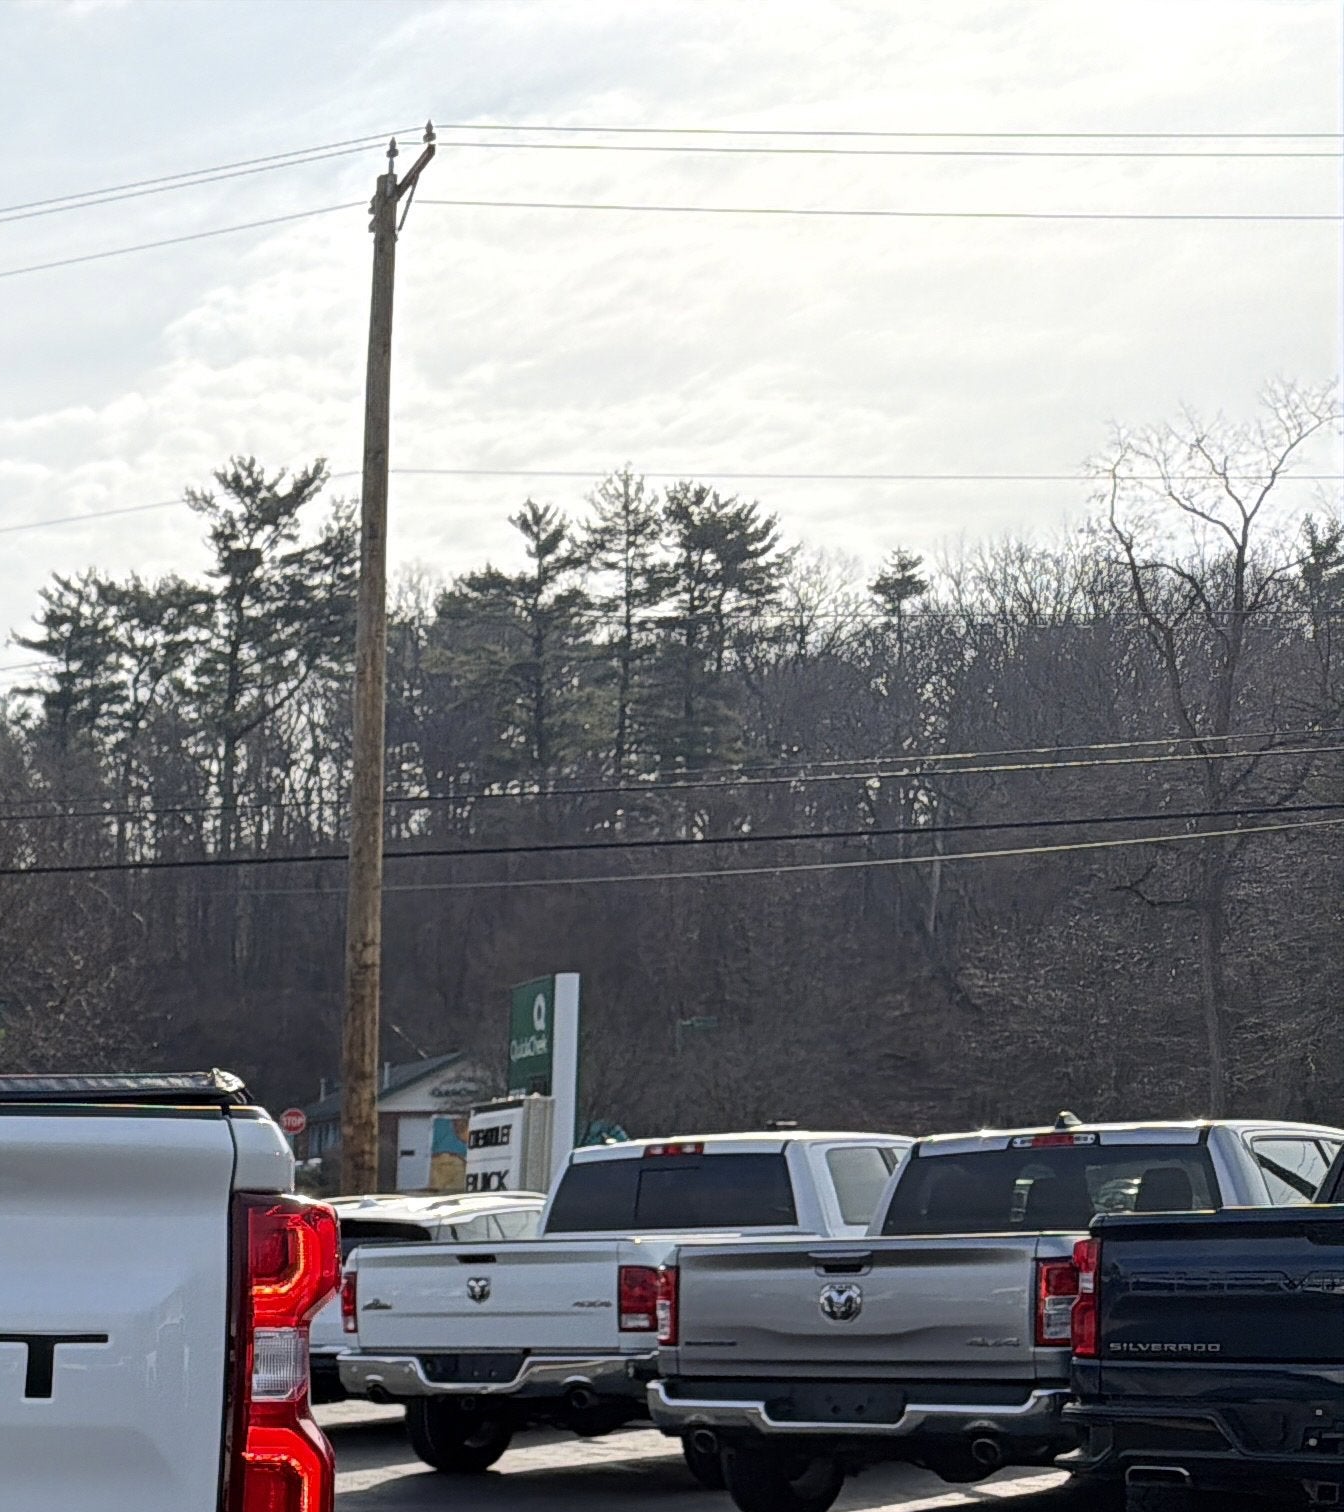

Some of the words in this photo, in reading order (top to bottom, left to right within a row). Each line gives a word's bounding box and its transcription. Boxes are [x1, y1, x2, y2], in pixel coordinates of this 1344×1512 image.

[282, 1115, 305, 1127] STOP
[465, 1169, 510, 1192] BUICK
[1109, 1342, 1221, 1352] SILVERADO
